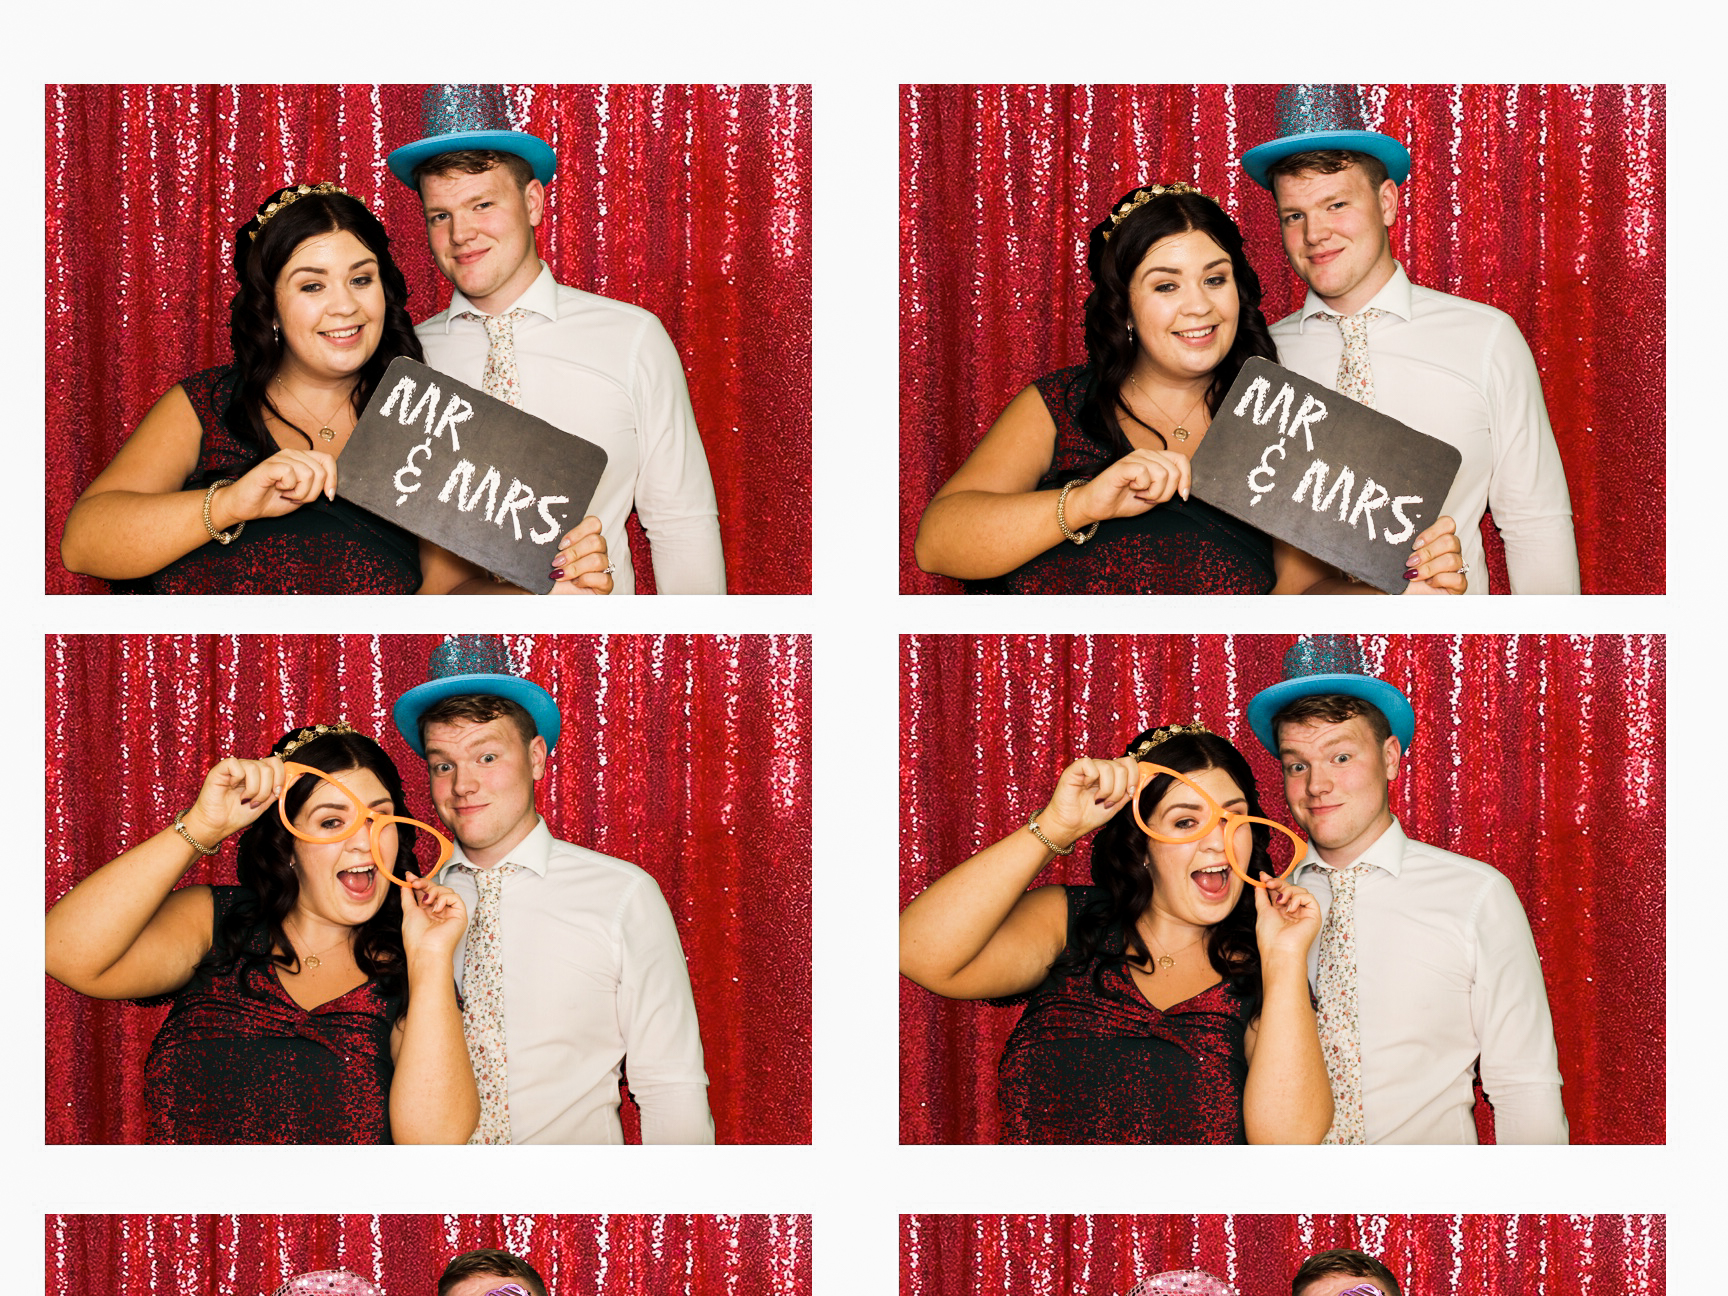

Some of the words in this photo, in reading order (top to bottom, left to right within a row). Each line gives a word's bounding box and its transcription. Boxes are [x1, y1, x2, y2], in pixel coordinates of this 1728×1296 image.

[379, 375, 474, 452] MR
[1233, 375, 1328, 452] MR
[393, 437, 432, 507] &
[1247, 437, 1286, 507] &
